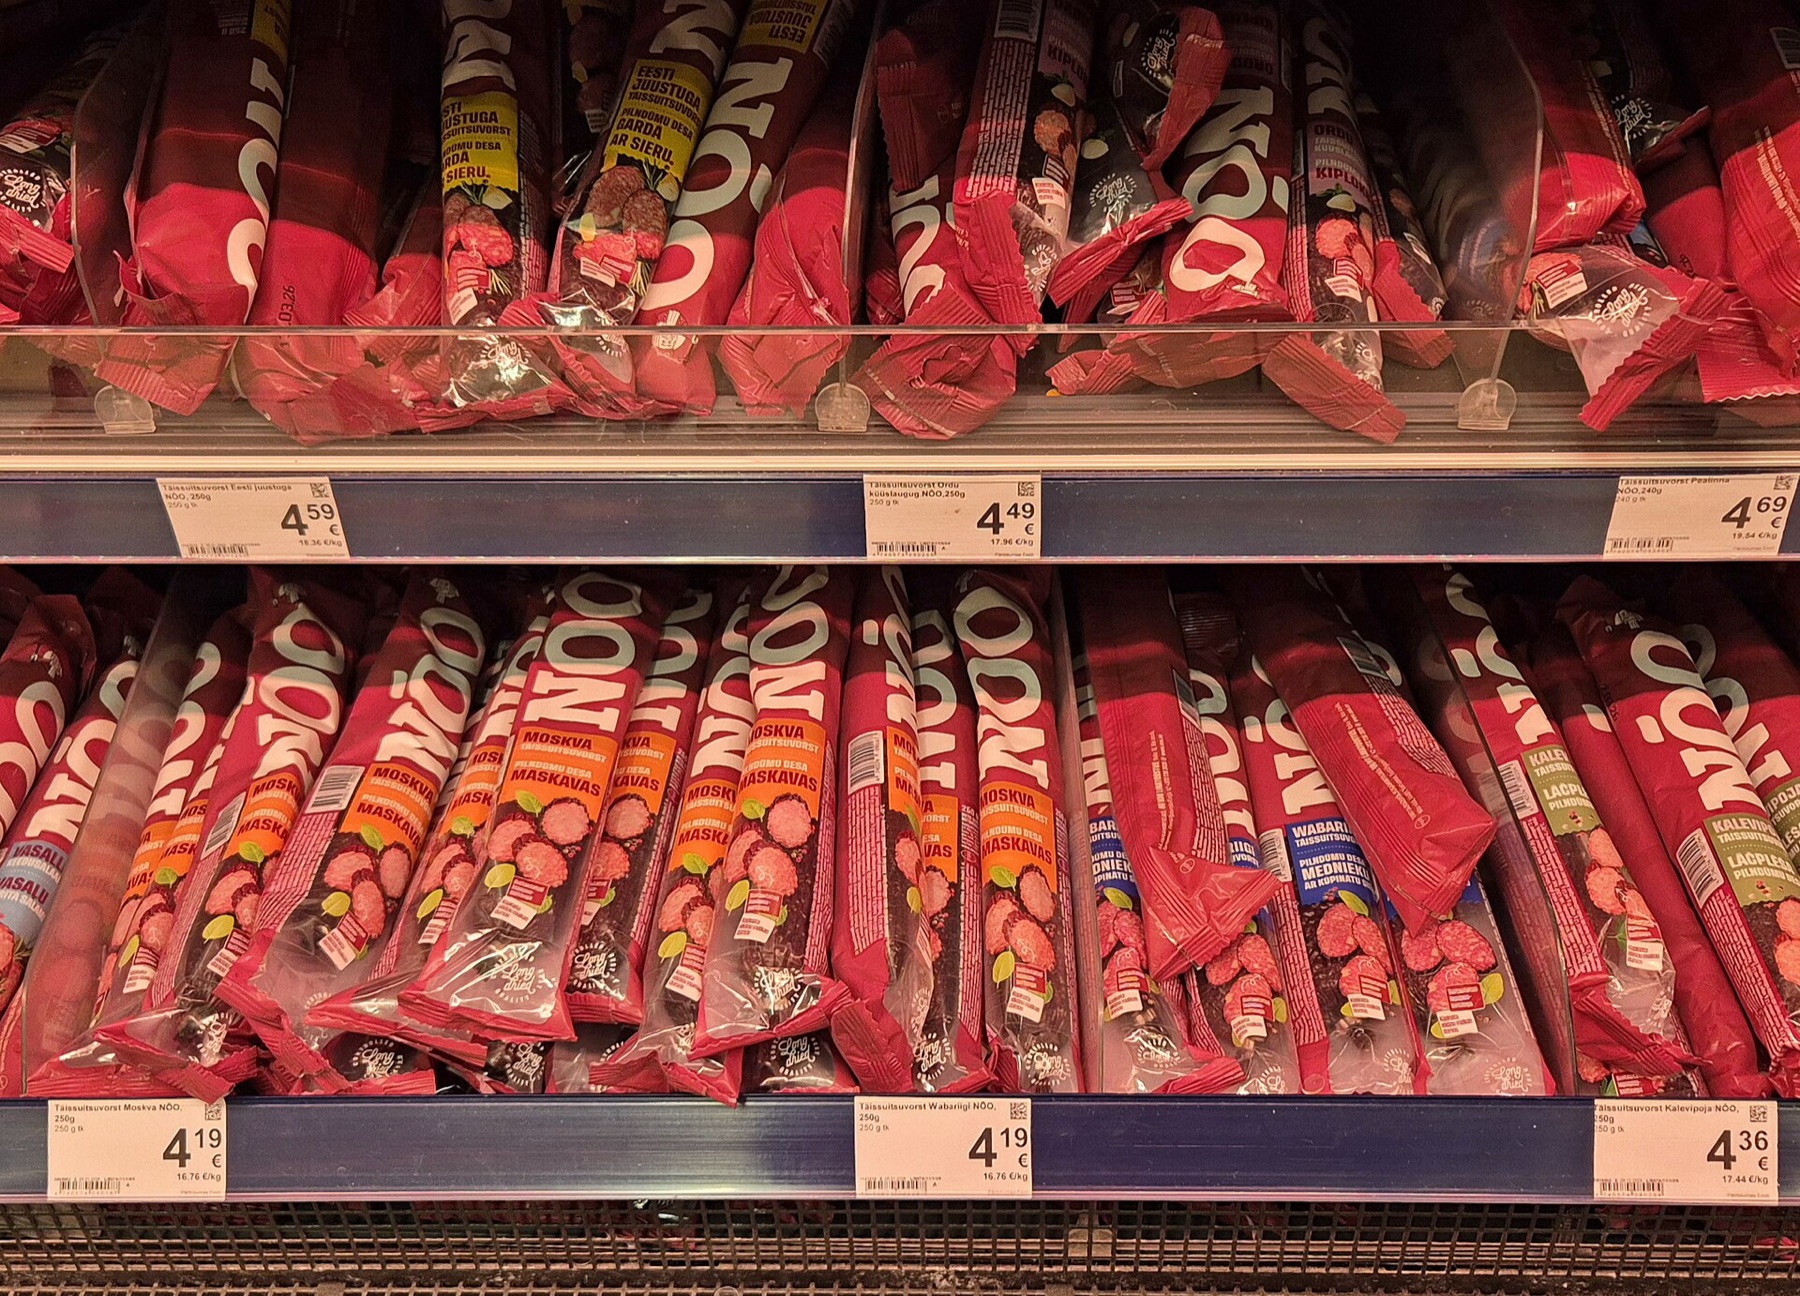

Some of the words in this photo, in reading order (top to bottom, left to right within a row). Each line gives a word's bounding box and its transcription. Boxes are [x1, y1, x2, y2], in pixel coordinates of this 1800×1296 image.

[638, 66, 676, 81] EESTI
[632, 78, 702, 112] JUUSTUGA
[672, 120, 694, 142] DESA
[610, 133, 628, 146] AR
[4, 174, 41, 195] Long
[6, 189, 40, 209] dried
[231, 484, 253, 492] Eesti
[254, 484, 292, 492] juustuga
[190, 493, 212, 502] 250g
[281, 504, 309, 536] 4
[307, 504, 335, 520] 59
[976, 502, 1004, 535] 4
[1006, 502, 1035, 520] 49
[1721, 496, 1752, 528] 4
[1756, 496, 1787, 512] 69
[329, 524, 340, 536] €
[1024, 523, 1034, 536] €
[1770, 516, 1782, 528] €
[324, 539, 342, 548] €/kg
[991, 538, 1012, 546] 17.96
[1015, 538, 1034, 546] €/kg
[1758, 532, 1778, 540] €/kg
[523, 731, 593, 750] MOSKVA
[566, 766, 593, 779] DESA
[784, 759, 808, 772] DESA
[373, 767, 434, 804] MOSKVA
[510, 768, 601, 797] MASKAVAS
[356, 802, 422, 852] MASKAVA
[1024, 828, 1043, 844] DESA
[982, 836, 1052, 865] MASKAVAS
[1304, 880, 1317, 890] AR
[574, 952, 606, 970] Long
[502, 963, 535, 980] Long
[578, 960, 610, 980] dried
[503, 976, 536, 994] dried
[778, 1036, 808, 1056] Long
[914, 1039, 940, 1058] Long
[362, 1048, 395, 1065] Long
[518, 1042, 544, 1067] Long
[786, 1044, 816, 1068] dried
[920, 1046, 947, 1072] dried
[1034, 1051, 1062, 1070] Long
[512, 1059, 540, 1084] dried
[1491, 1066, 1522, 1080] Long
[1502, 1078, 1528, 1092] dried
[124, 1104, 156, 1112] Moskva
[159, 1102, 182, 1112] NÕO,
[928, 1102, 971, 1112] Wabariigi
[973, 1101, 996, 1111] NÕO,
[1665, 1104, 1712, 1114] Kalevipoja
[1715, 1104, 1740, 1114] NÕO,
[54, 1114, 75, 1123] 250g
[860, 1114, 880, 1122] 250g
[162, 1128, 192, 1168] 4
[194, 1128, 222, 1148] 19
[968, 1127, 998, 1168] 4
[1000, 1127, 1028, 1148] 19
[1706, 1130, 1736, 1170] 4
[1738, 1130, 1768, 1151] 36
[212, 1154, 222, 1168] €
[1018, 1153, 1028, 1168] €
[1758, 1156, 1768, 1170] €
[177, 1172, 200, 1181] 16.76
[202, 1172, 222, 1182] €/kg
[984, 1172, 1006, 1180] 16.76
[1008, 1172, 1028, 1182] €/kg
[1722, 1176, 1746, 1184] 17.44
[1749, 1176, 1768, 1185] €/kg
